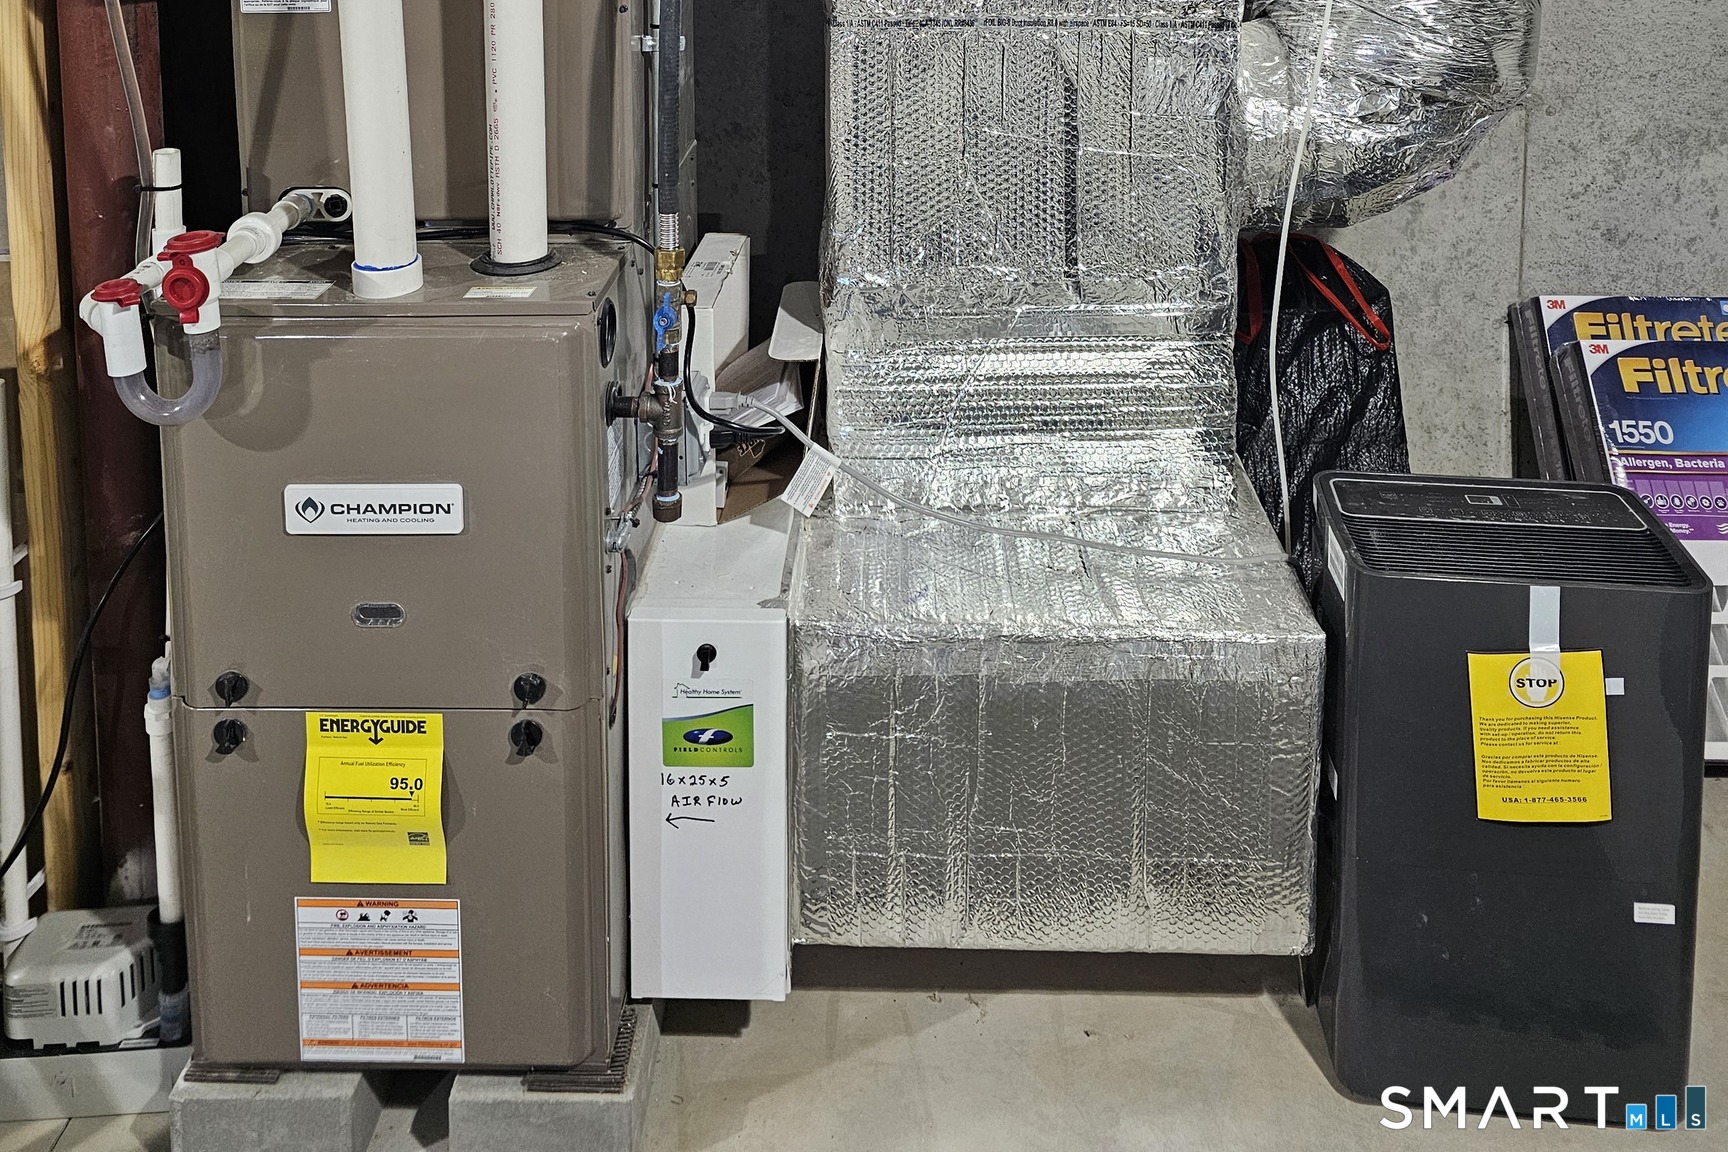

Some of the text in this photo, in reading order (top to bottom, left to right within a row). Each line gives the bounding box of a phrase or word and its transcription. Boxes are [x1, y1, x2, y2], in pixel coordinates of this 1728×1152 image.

[490, 24, 496, 35] PR
[1546, 300, 1566, 309] 3M
[1588, 344, 1609, 354] 3M
[1617, 357, 1728, 394] Filtr
[1608, 420, 1674, 445] 1550
[1620, 457, 1725, 469] Allergen, Bacteria
[330, 503, 451, 514] CHAMPION
[1516, 678, 1558, 688] STOP
[320, 718, 426, 735] ENERGYGUIDE
[390, 777, 423, 791] 95.0
[670, 795, 701, 807] AIR
